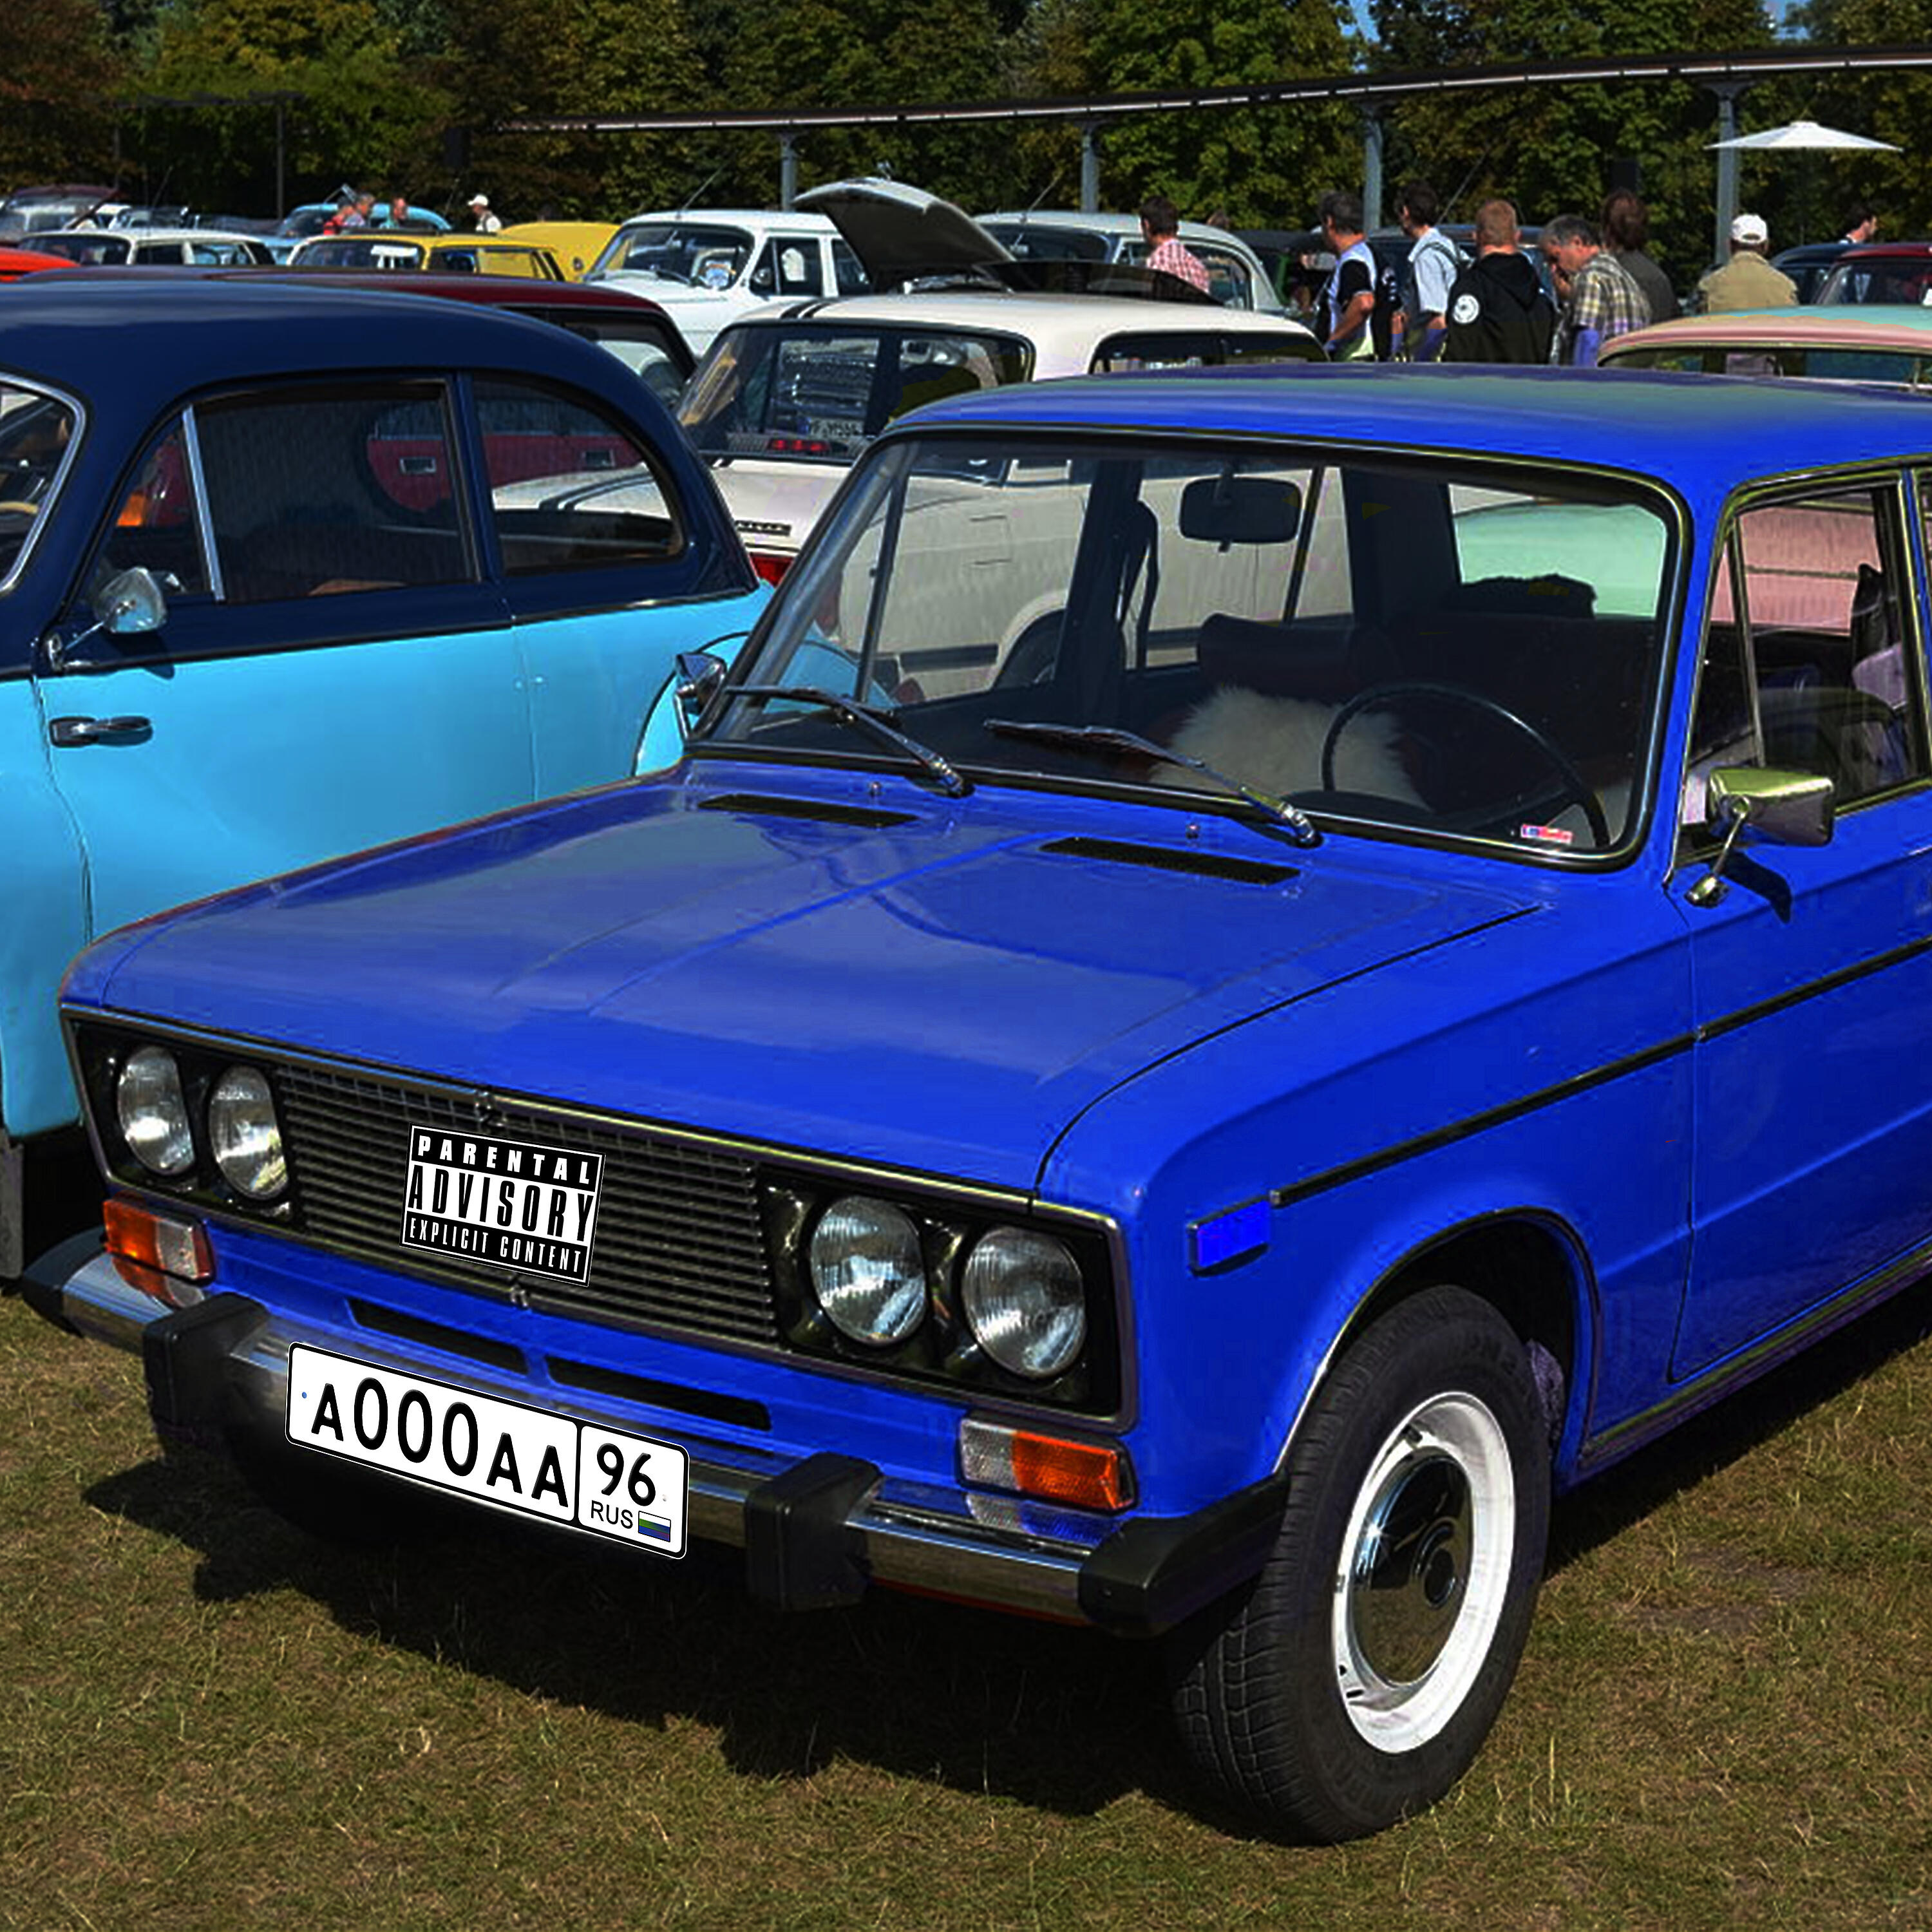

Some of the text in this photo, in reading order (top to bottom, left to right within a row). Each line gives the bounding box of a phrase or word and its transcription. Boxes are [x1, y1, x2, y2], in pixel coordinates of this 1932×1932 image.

[417, 1135, 591, 1185] PARENTAL
[407, 1164, 594, 1243] ADVISORY
[410, 1217, 581, 1273] EXPLICIT CONTENT
[596, 1443, 656, 1507] 96
[591, 1499, 634, 1530] RUS
